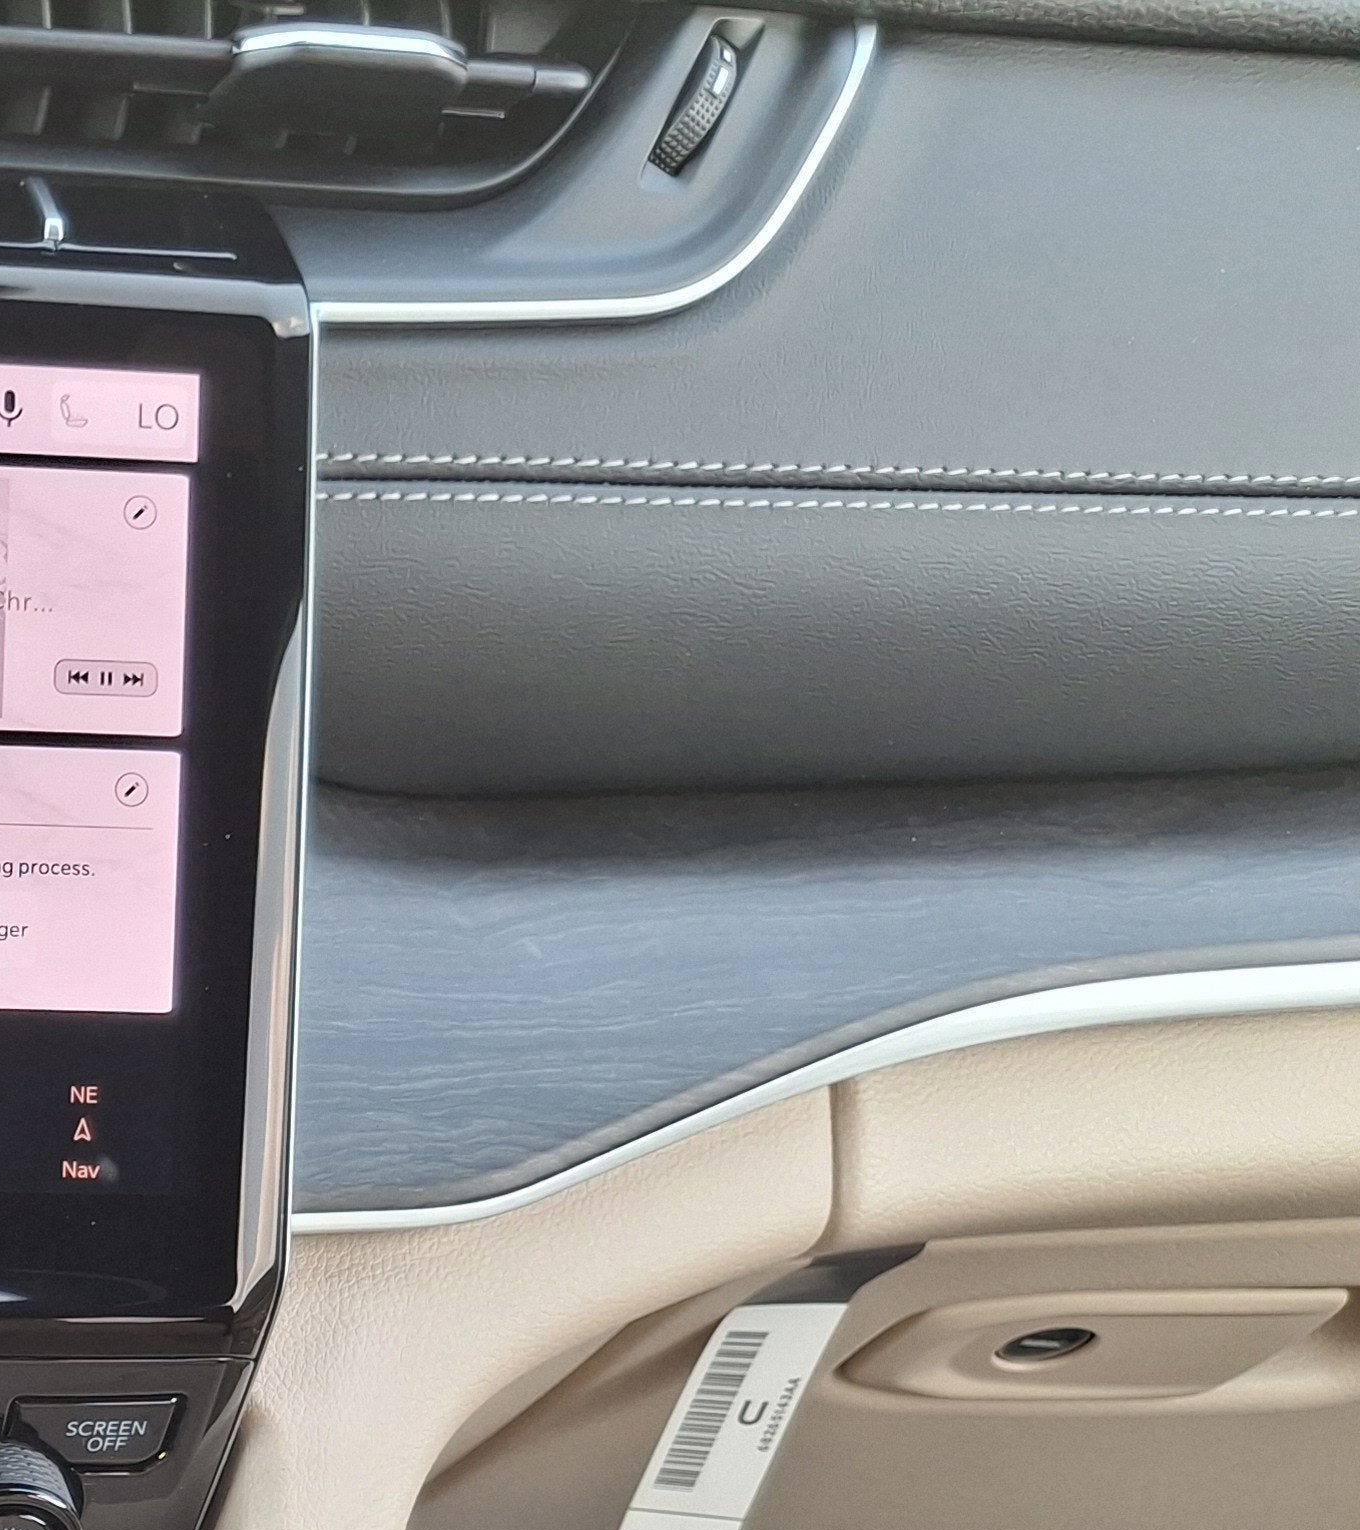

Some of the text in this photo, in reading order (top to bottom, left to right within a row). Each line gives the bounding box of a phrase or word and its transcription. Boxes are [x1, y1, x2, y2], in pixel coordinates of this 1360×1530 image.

[138, 403, 179, 431] LO
[19, 861, 95, 880] process.
[70, 1086, 98, 1104] NE
[62, 1161, 100, 1179] Nav
[738, 1399, 769, 1426] U
[66, 1420, 147, 1437] SCREEN
[87, 1436, 127, 1453] OFF
